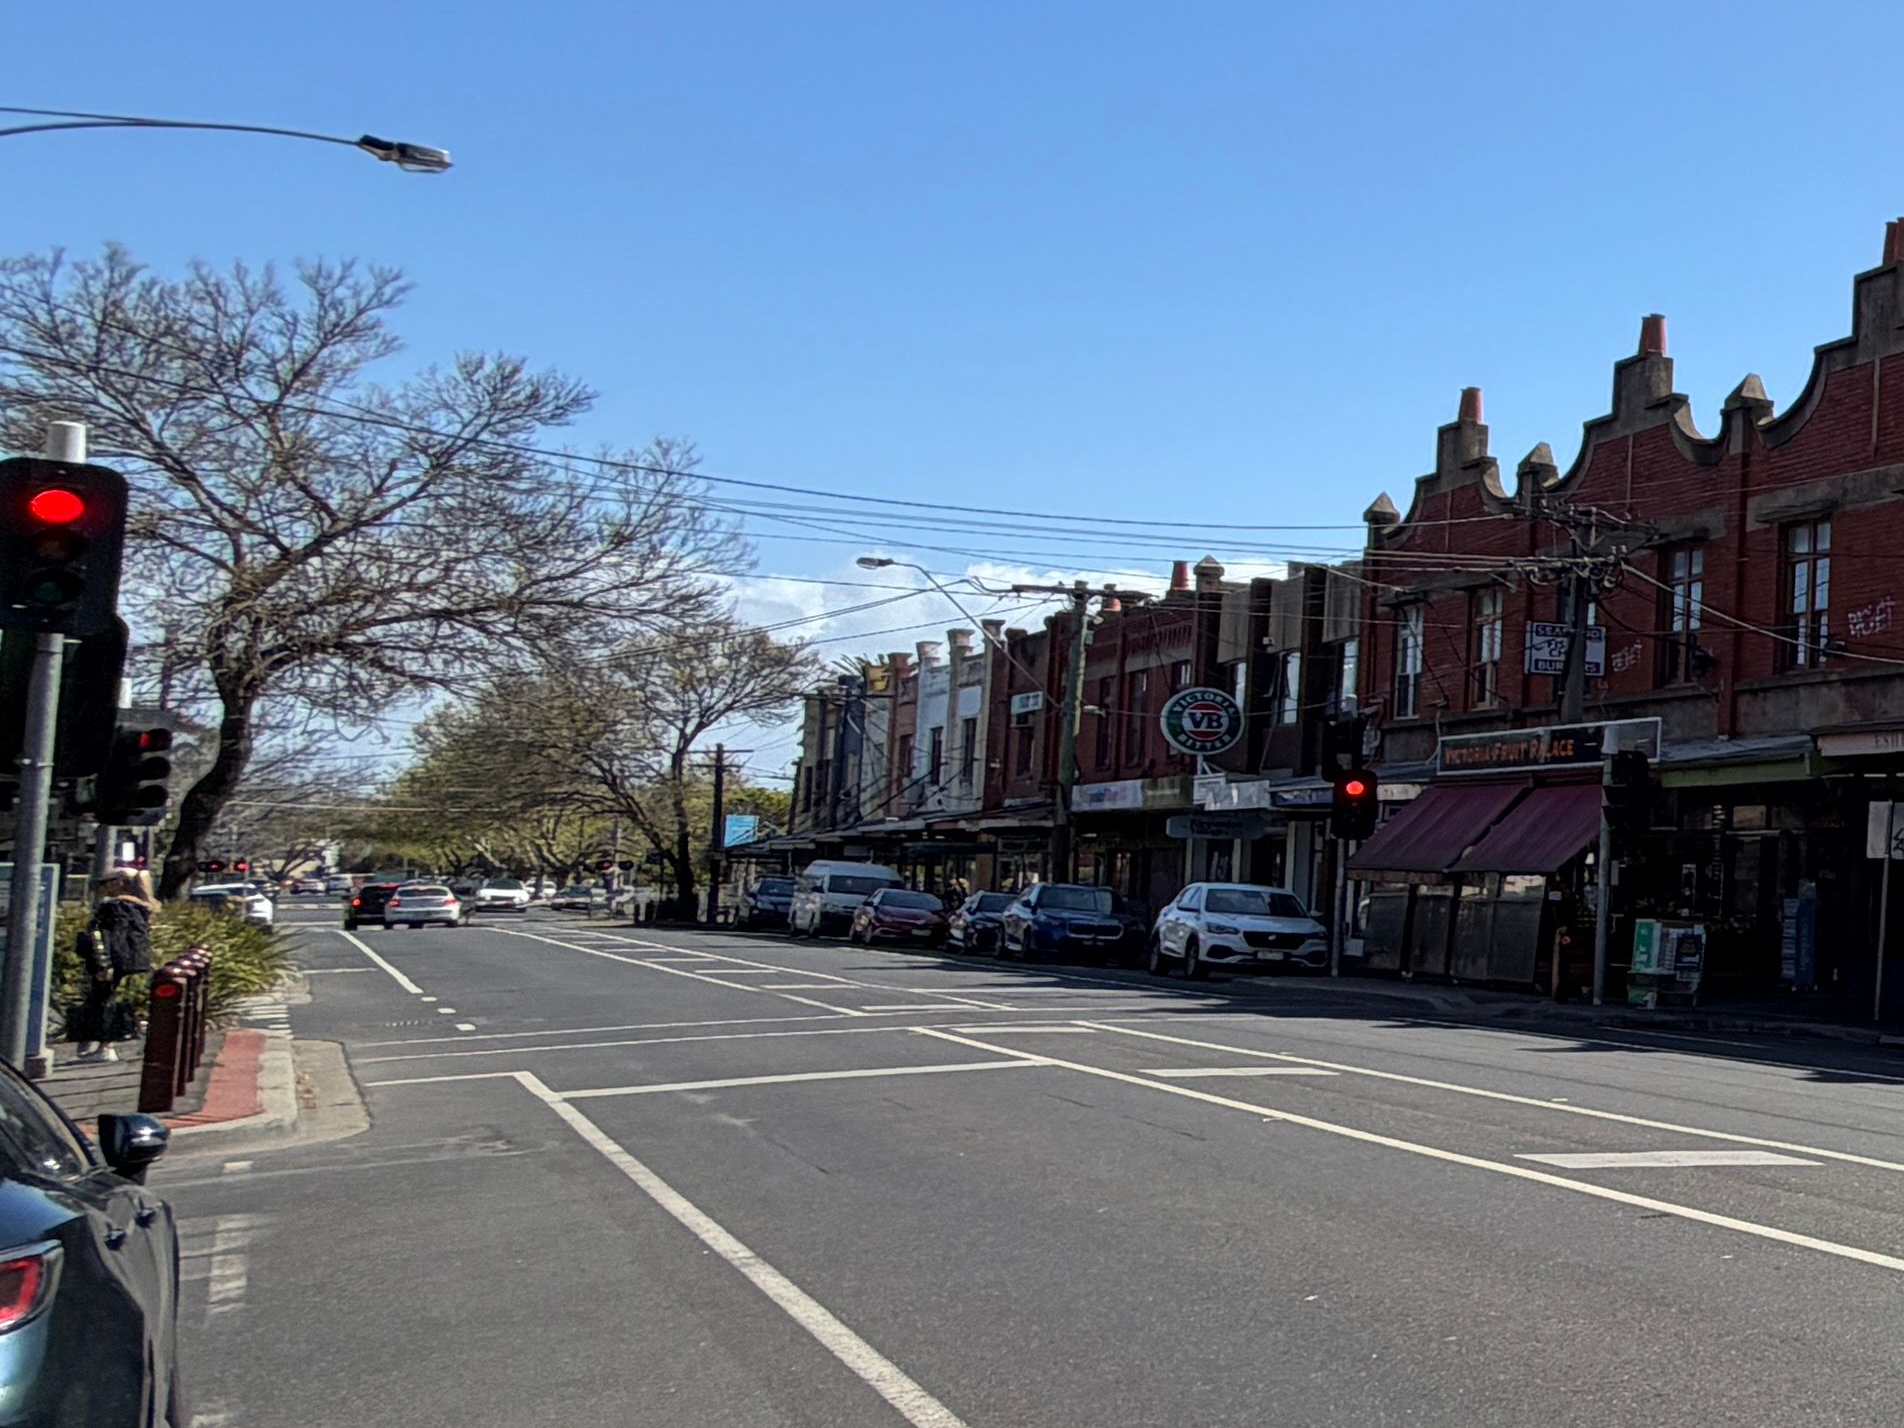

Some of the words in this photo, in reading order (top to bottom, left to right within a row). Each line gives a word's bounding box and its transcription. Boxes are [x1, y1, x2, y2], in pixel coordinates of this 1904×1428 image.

[1173, 692, 1237, 715] VICTORIA
[1187, 712, 1224, 730] VB
[1177, 734, 1232, 750] BITTER
